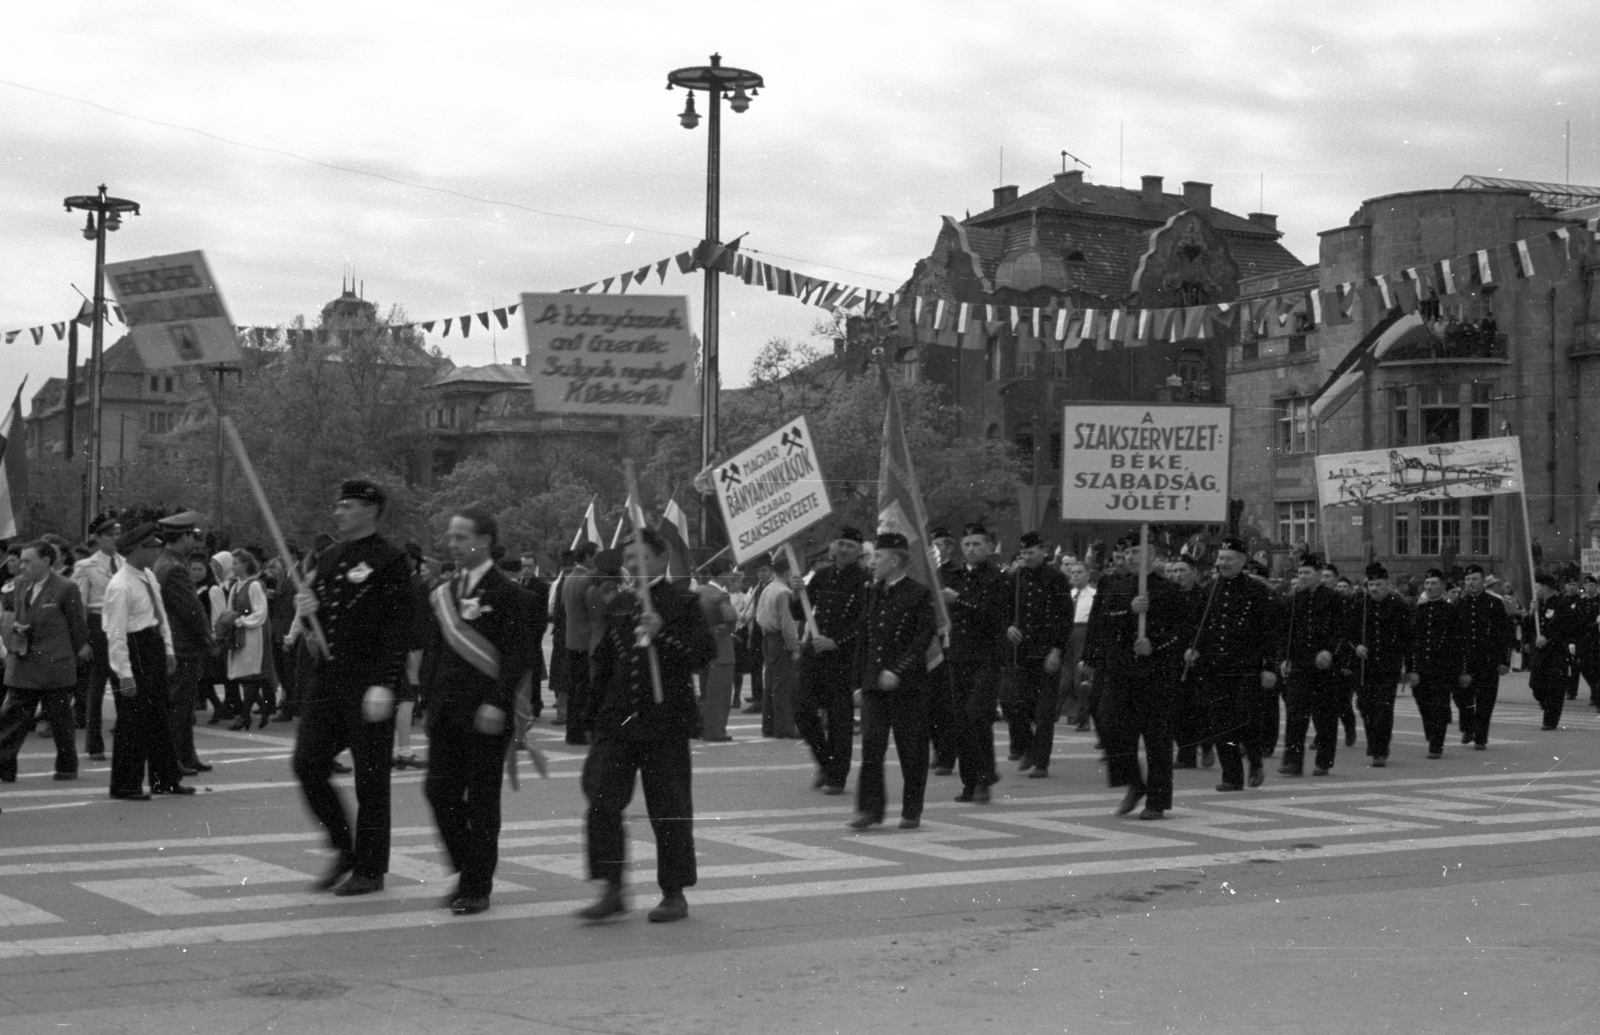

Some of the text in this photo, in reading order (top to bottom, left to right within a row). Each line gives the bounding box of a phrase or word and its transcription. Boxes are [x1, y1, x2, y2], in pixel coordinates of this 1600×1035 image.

[1141, 411, 1154, 424] A
[1073, 422, 1223, 451] SZAKSZERVEZET:
[742, 445, 780, 477] MAGYAR
[1111, 452, 1189, 471] BÉKE,
[725, 447, 814, 519] BÁNYAMUNKÁSOK
[1073, 471, 1220, 493] SZABADSÁG,
[755, 492, 792, 520] SZABAD
[738, 491, 820, 550] SZAKSZERVEZETE
